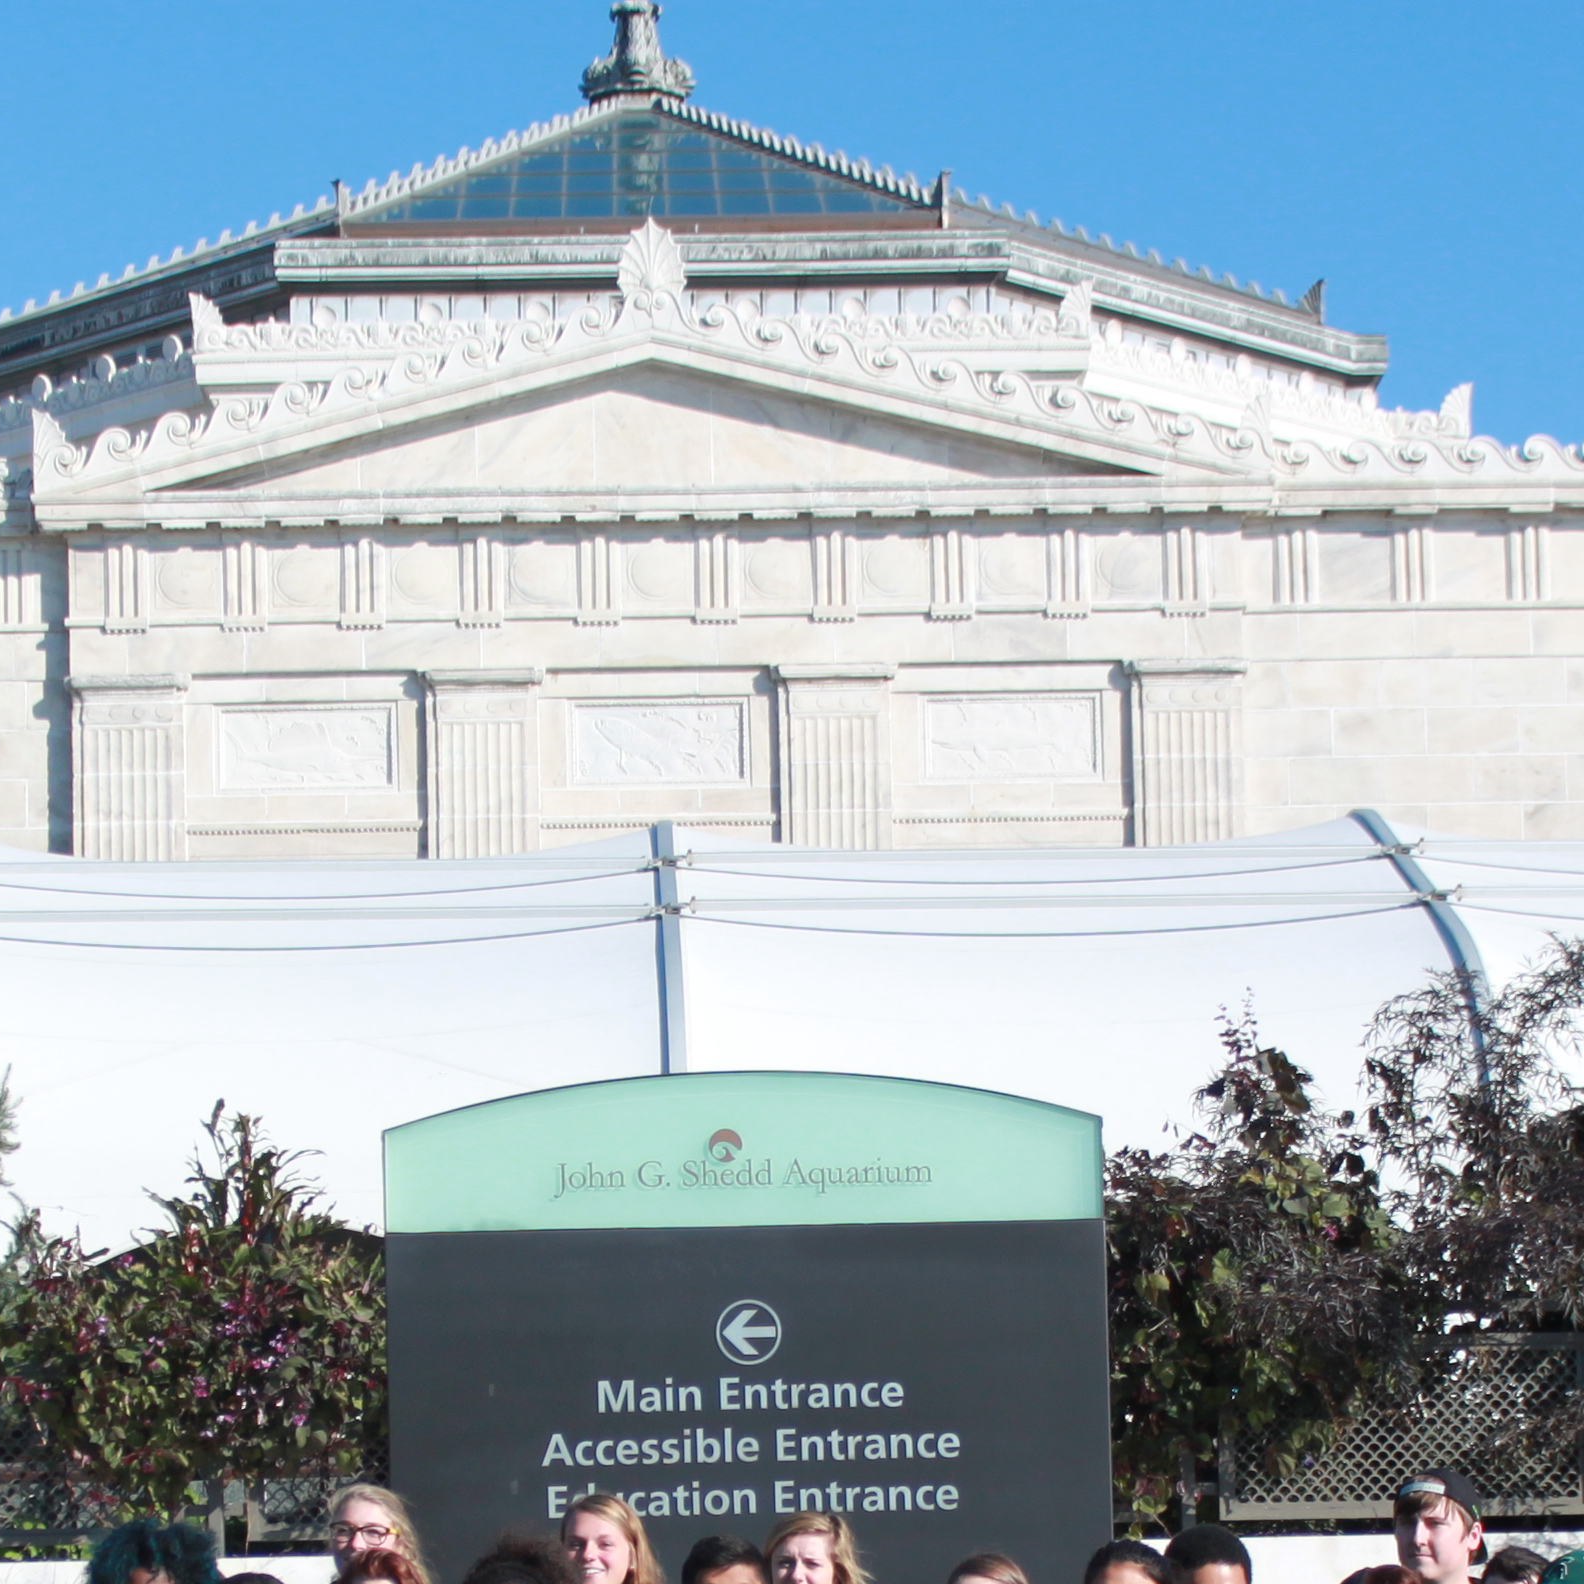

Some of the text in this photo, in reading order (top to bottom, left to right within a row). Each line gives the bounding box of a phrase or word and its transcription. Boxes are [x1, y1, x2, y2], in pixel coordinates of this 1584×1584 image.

[553, 1157, 933, 1199] John G. Shedd Aquarium
[597, 1376, 905, 1413] Main Entrance
[541, 1427, 961, 1468] Accessible Entrance
[547, 1480, 960, 1519] Ecation Entrance
